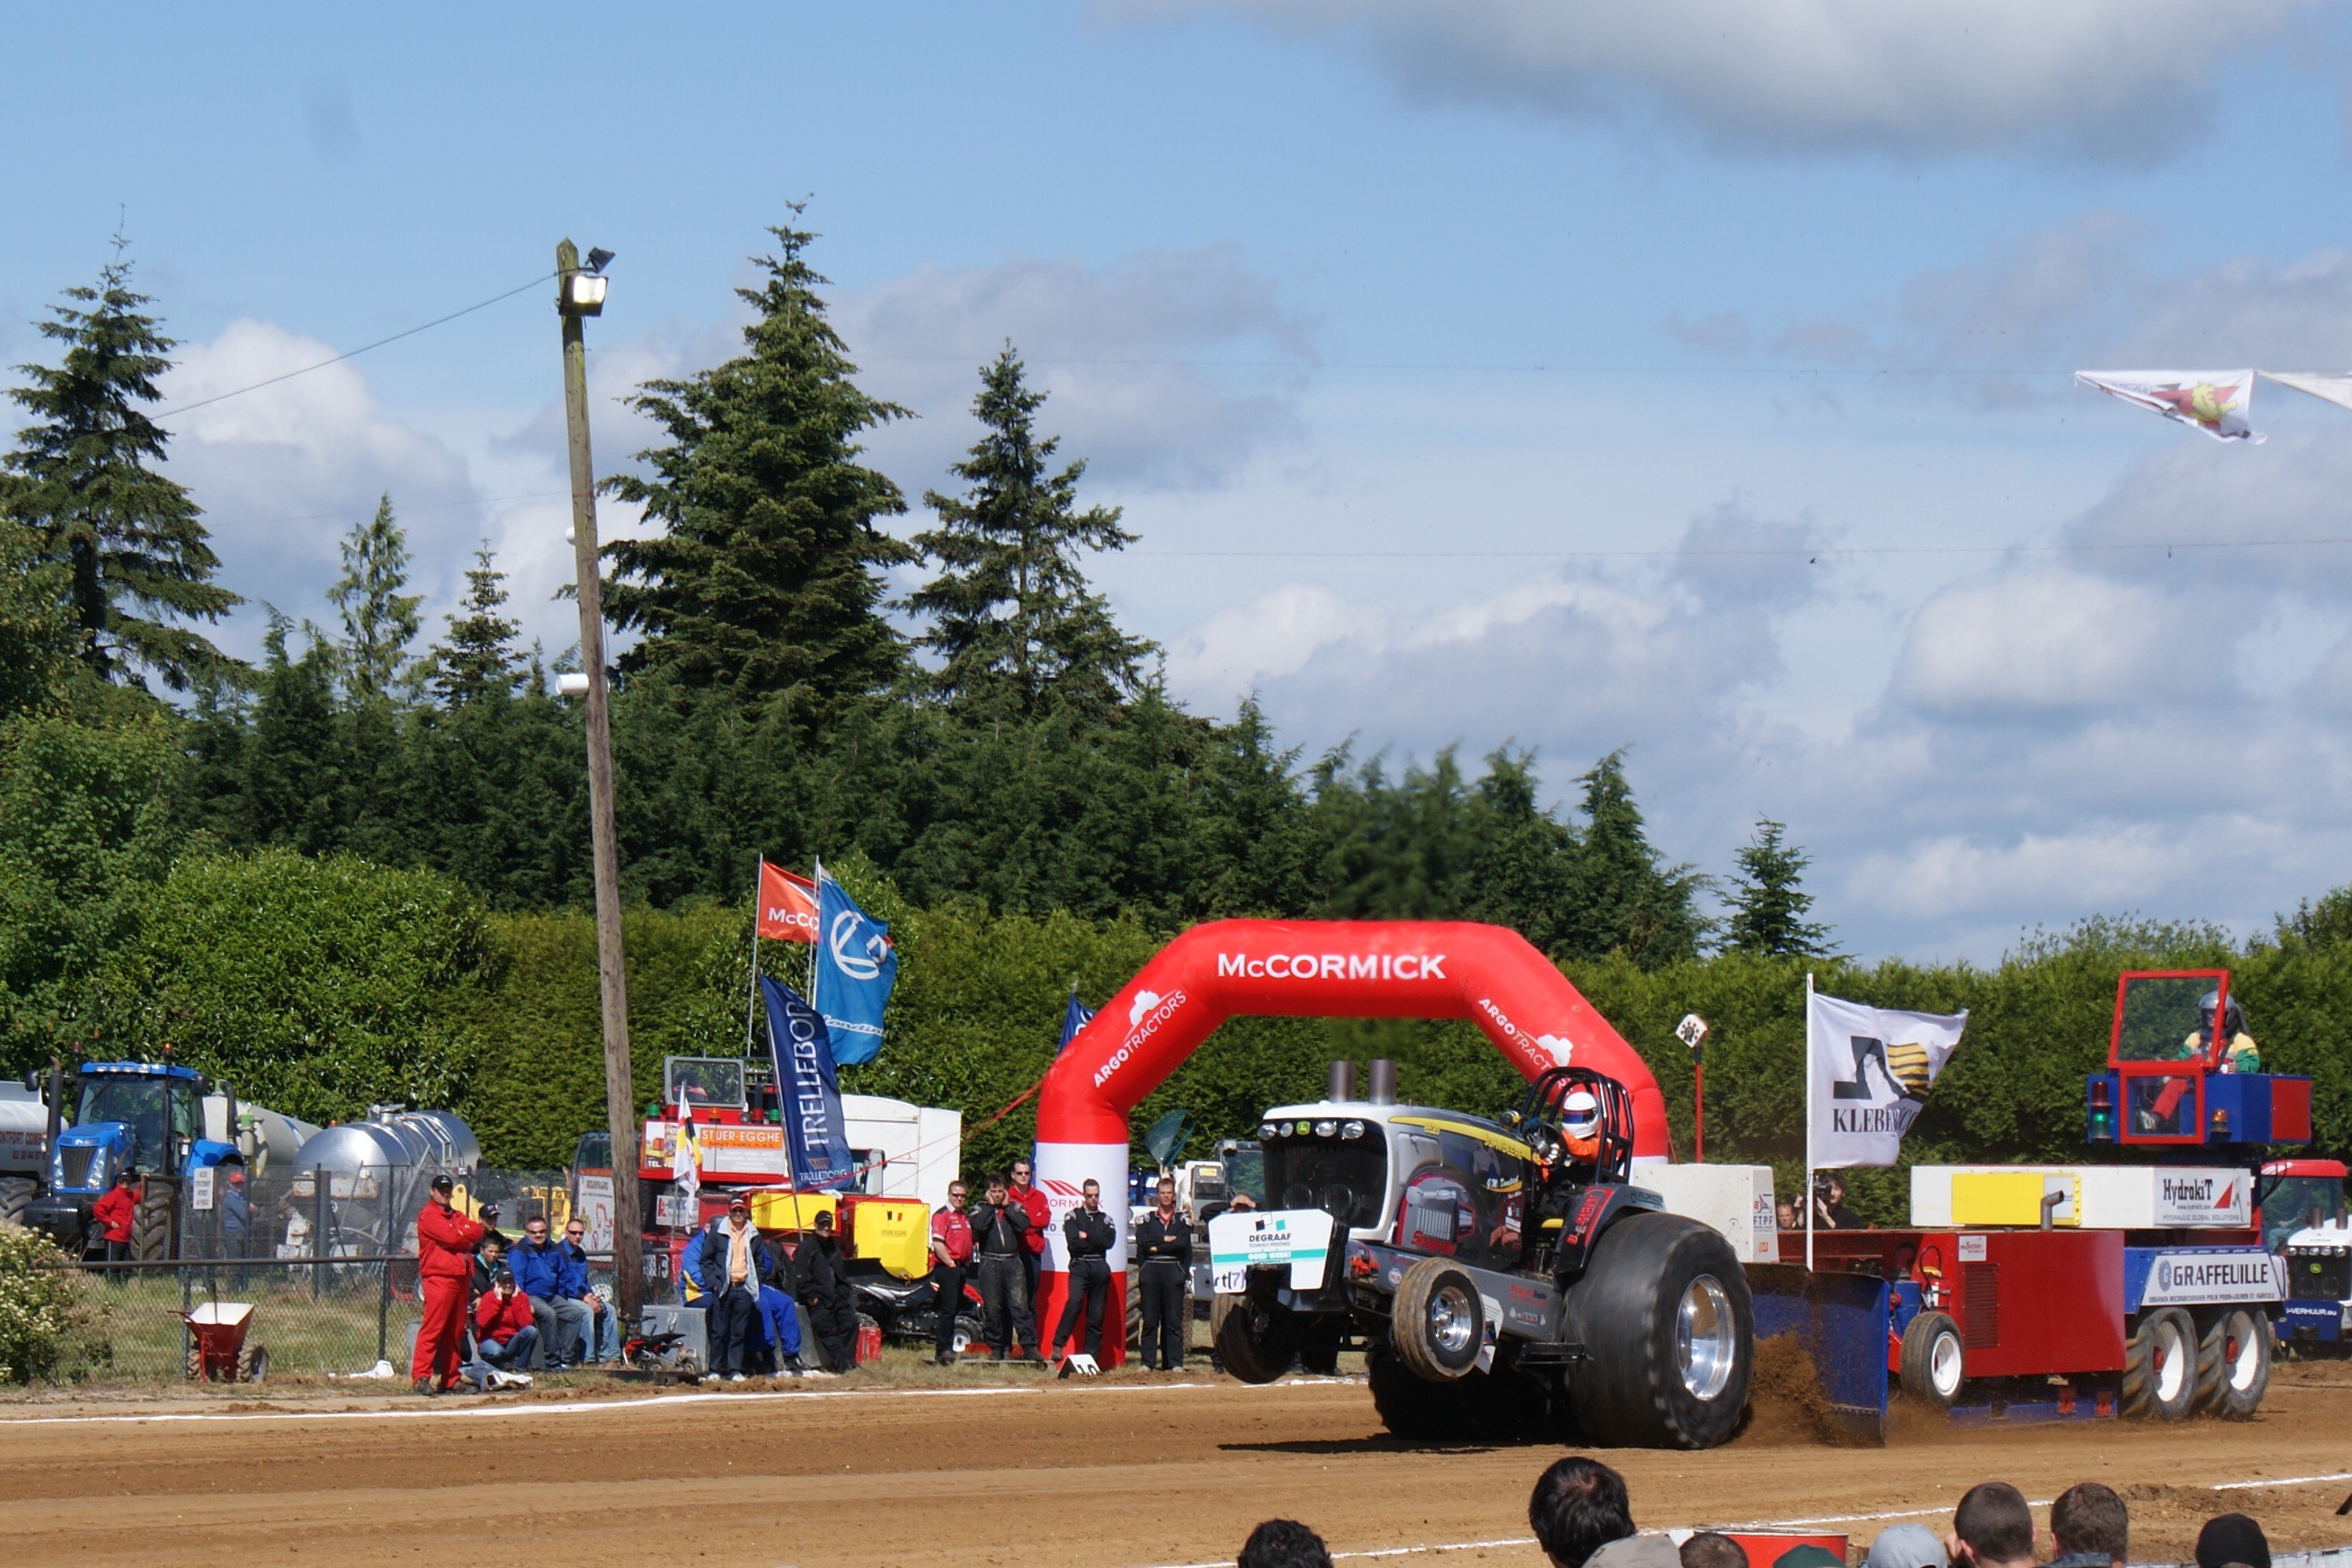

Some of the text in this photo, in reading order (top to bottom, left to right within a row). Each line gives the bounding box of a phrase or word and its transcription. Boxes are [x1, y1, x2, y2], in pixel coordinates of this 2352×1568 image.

[1218, 953, 1446, 979] McCORMICK
[1249, 1232, 1291, 1243] DEGRAAF
[2173, 1264, 2268, 1287] GRAFFEUILLE
